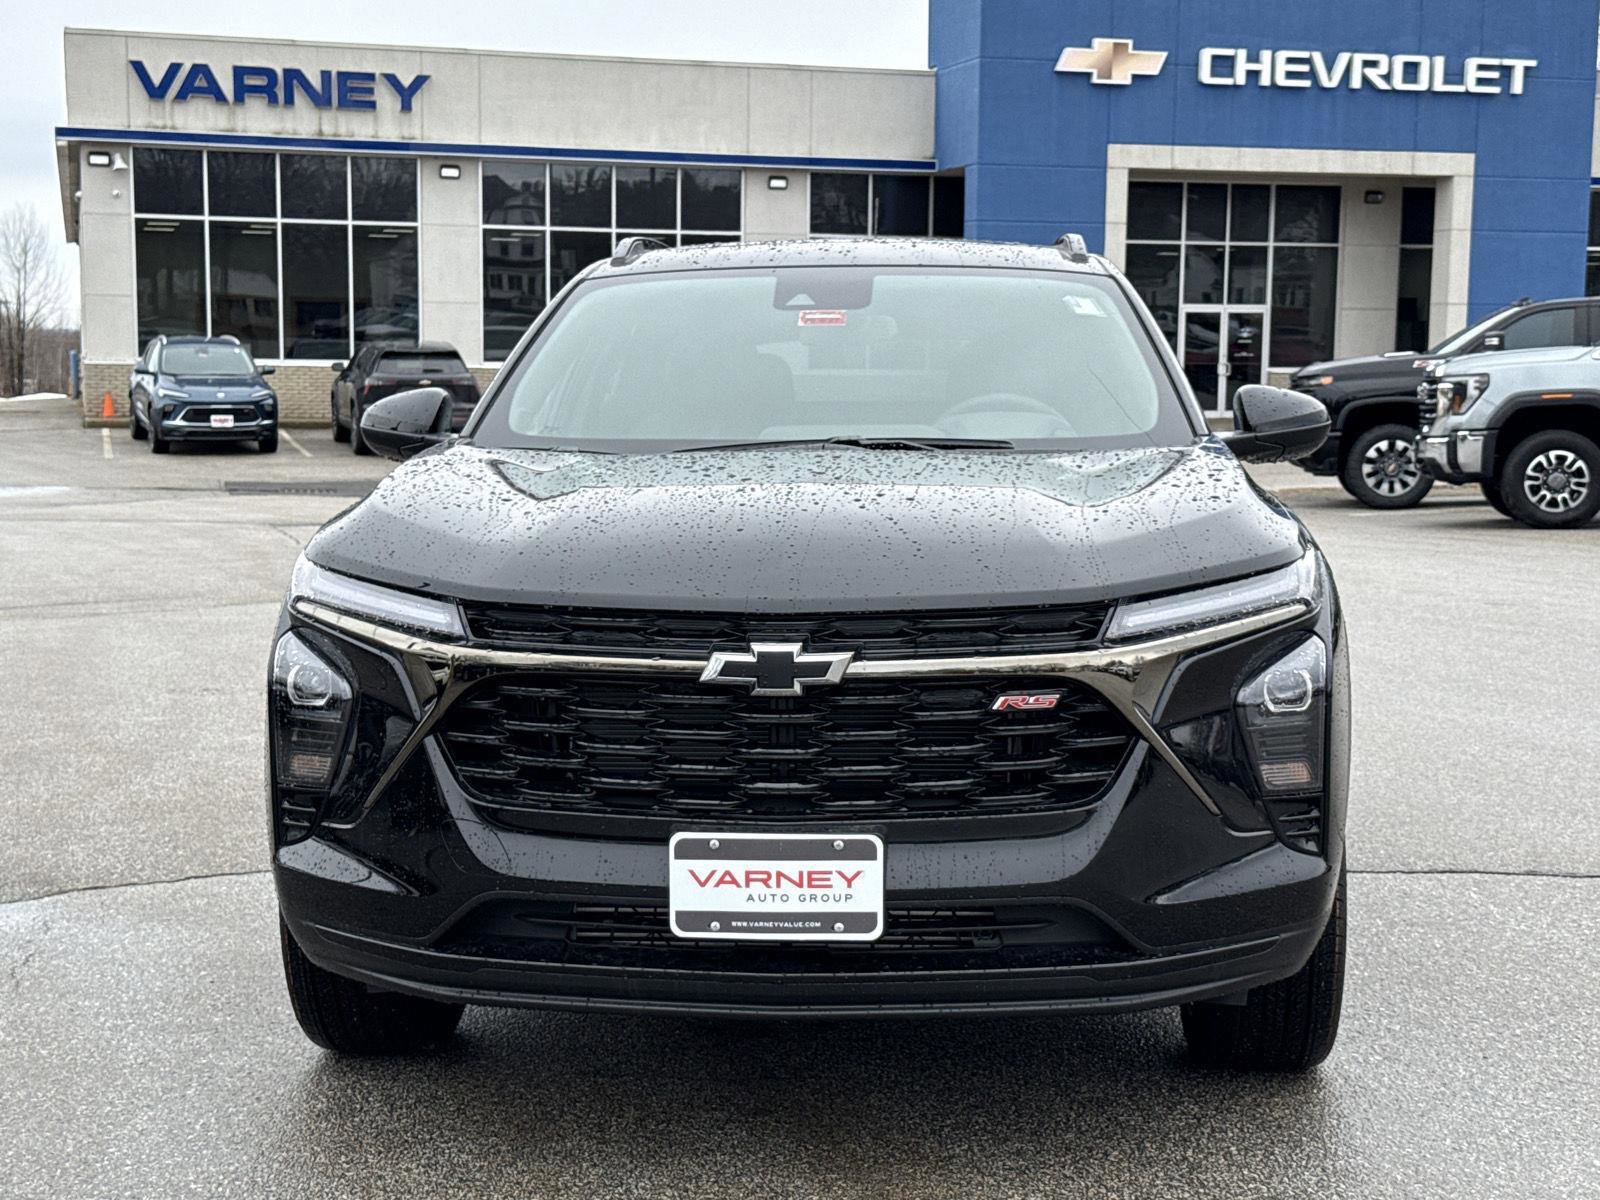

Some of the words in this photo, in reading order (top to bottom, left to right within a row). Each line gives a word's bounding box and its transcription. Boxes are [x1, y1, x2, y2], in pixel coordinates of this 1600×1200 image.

[1198, 47, 1538, 95] CHEVROLET
[128, 60, 431, 113] VARNEY
[992, 694, 1060, 710] RS
[688, 869, 863, 888] VARNEY
[746, 893, 790, 903] AUTO
[798, 893, 853, 903] GROUP
